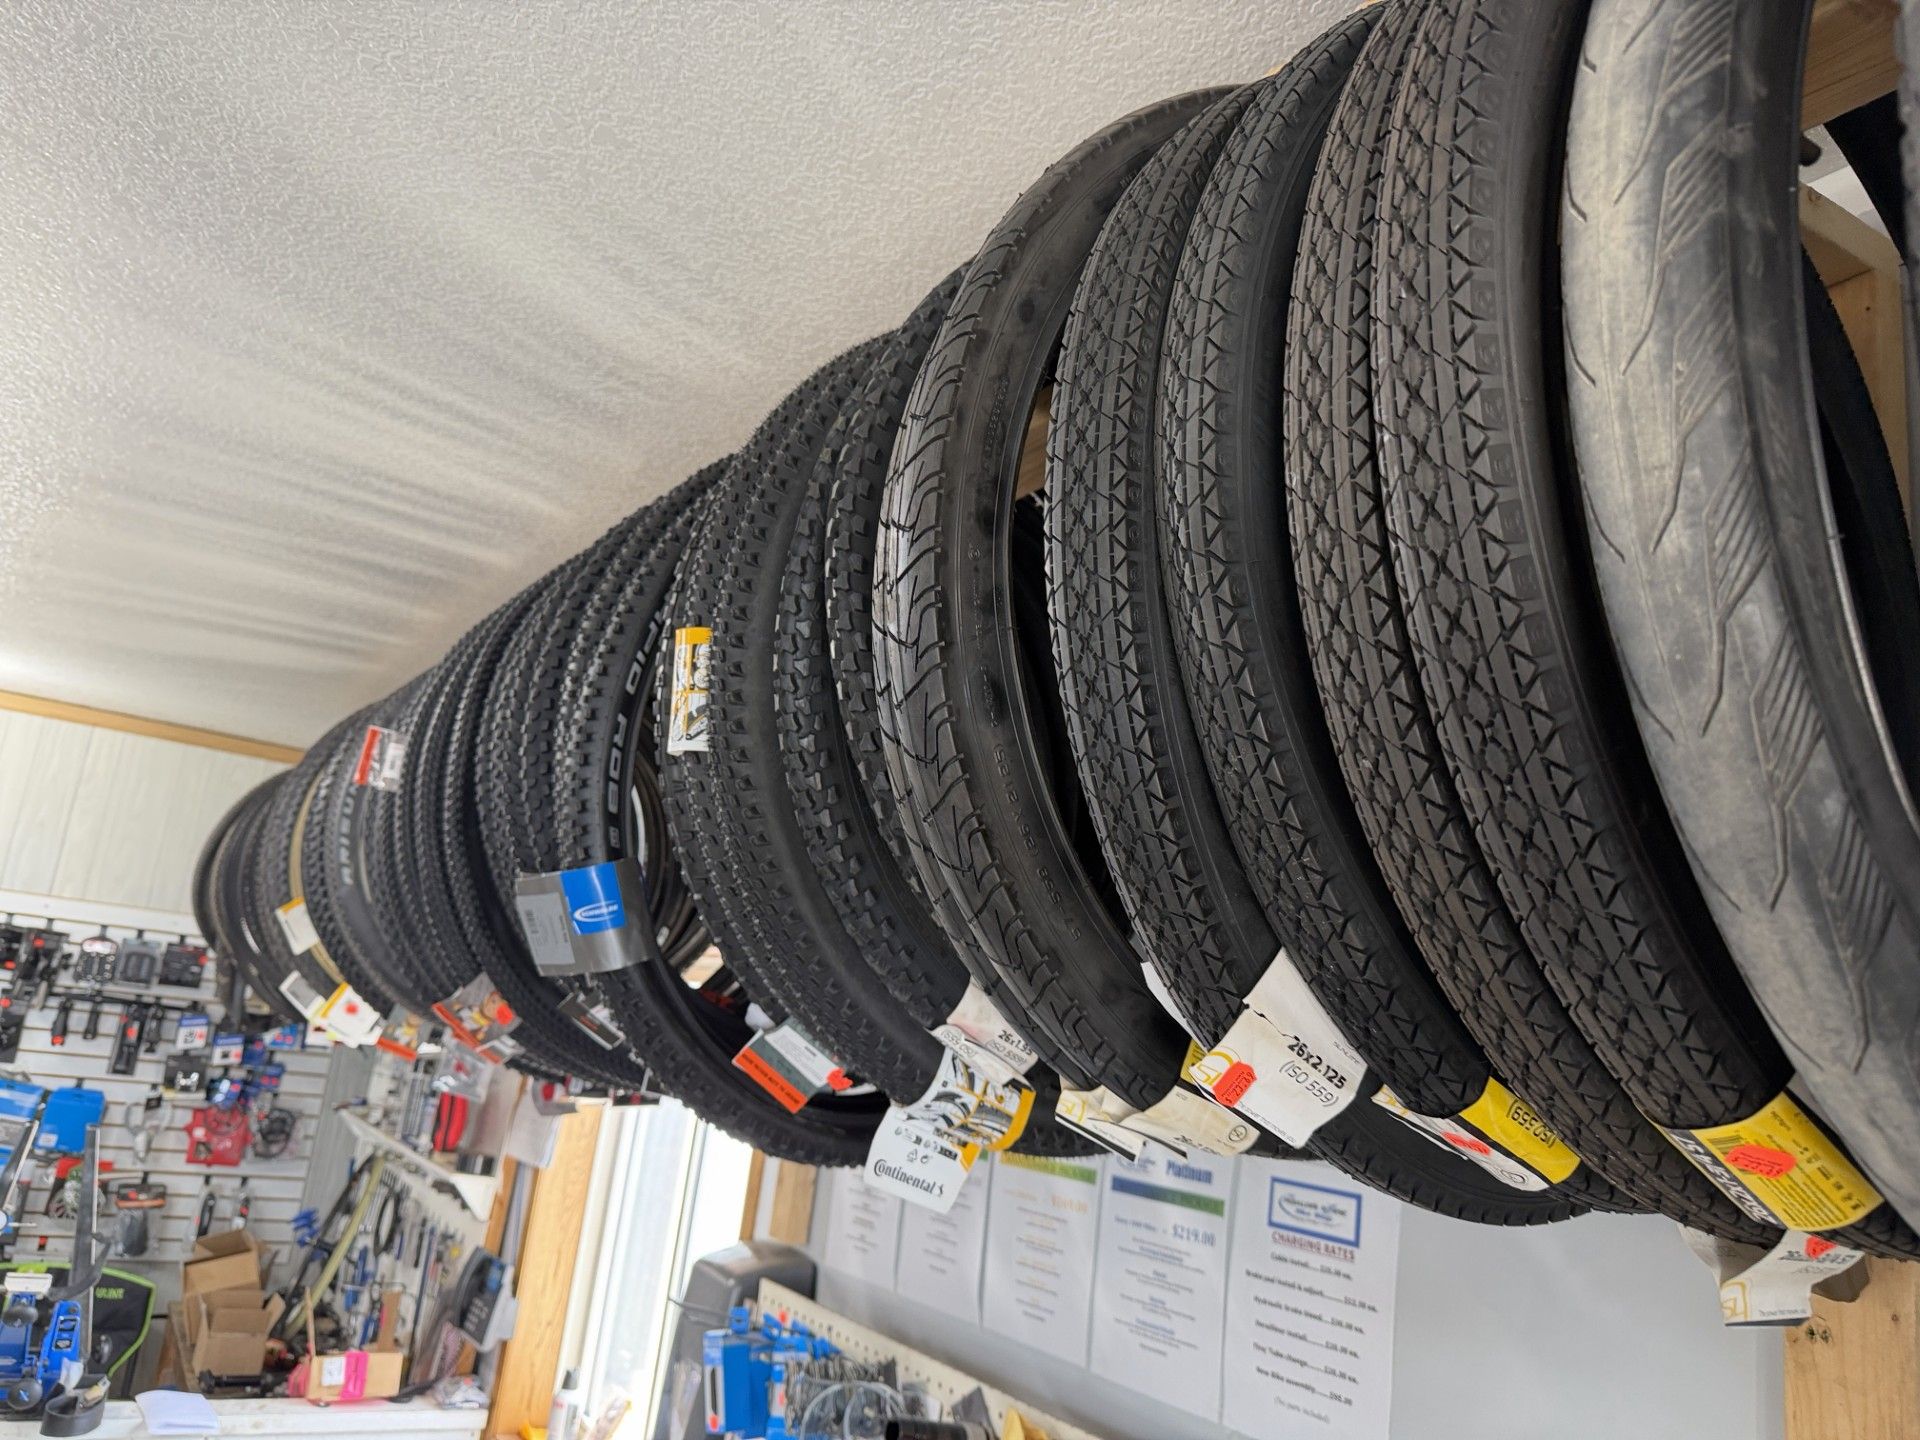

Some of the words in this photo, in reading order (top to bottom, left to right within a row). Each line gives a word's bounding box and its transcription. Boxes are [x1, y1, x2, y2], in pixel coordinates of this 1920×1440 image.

[1287, 1034, 1347, 1090] 26x2.125
[1279, 1060, 1308, 1085] (ISO
[1306, 1079, 1340, 1108] 559)
[873, 1158, 936, 1197] Continental
[1166, 1159, 1212, 1185] Platinum
[1271, 1231, 1323, 1253] CHARGING
[1323, 1243, 1356, 1262] RATES
